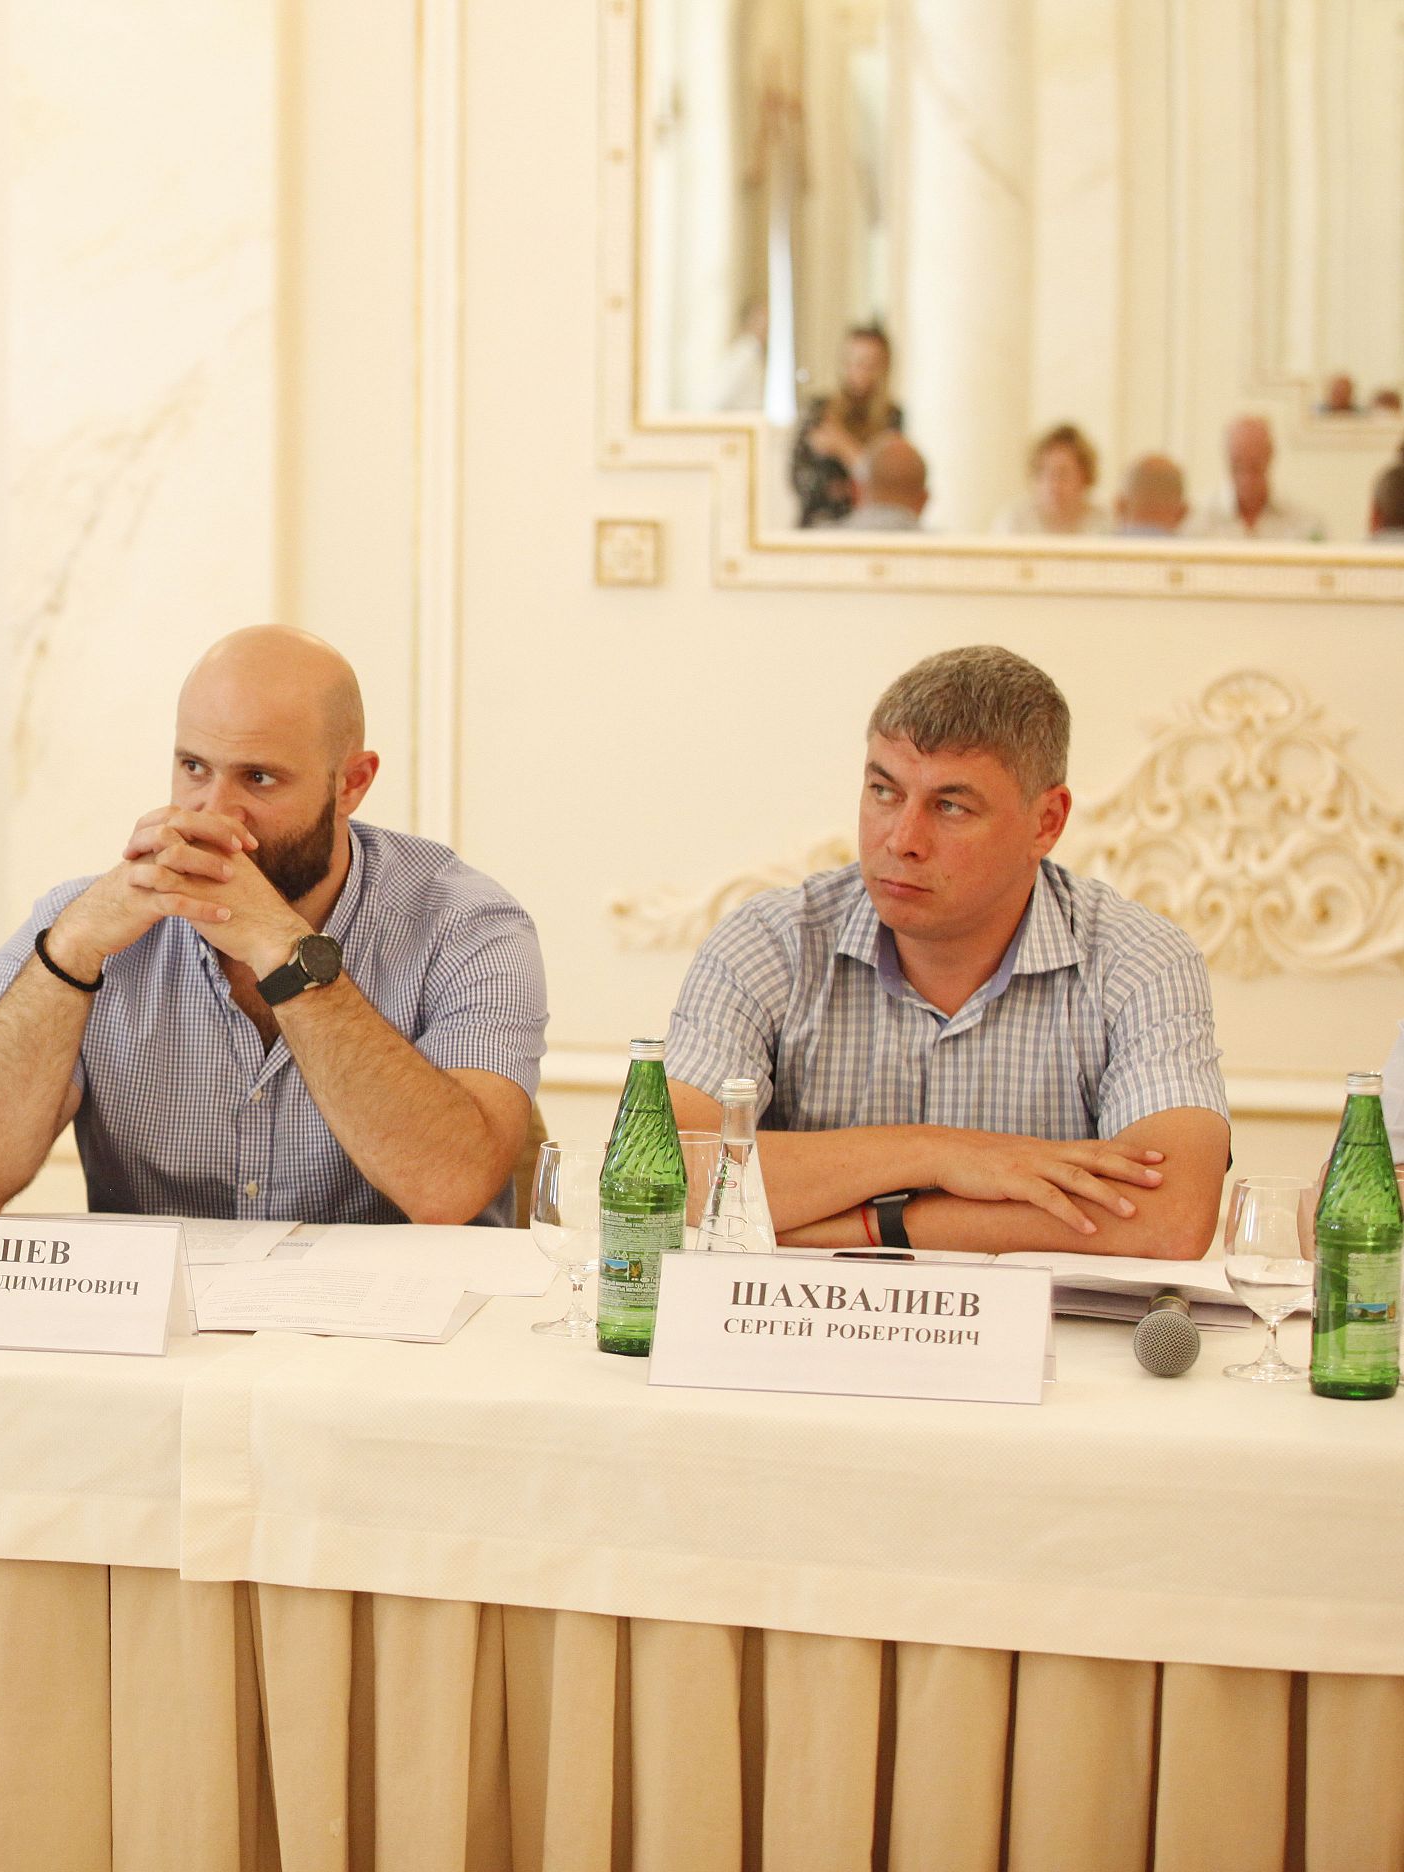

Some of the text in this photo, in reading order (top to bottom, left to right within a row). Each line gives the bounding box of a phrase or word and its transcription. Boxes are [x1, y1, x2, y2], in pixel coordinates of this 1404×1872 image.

[731, 1281, 980, 1318] ШАХВАЛИЕВ
[723, 1317, 980, 1346] СЕРГЕЙ РОБЕРТОВИЧ
